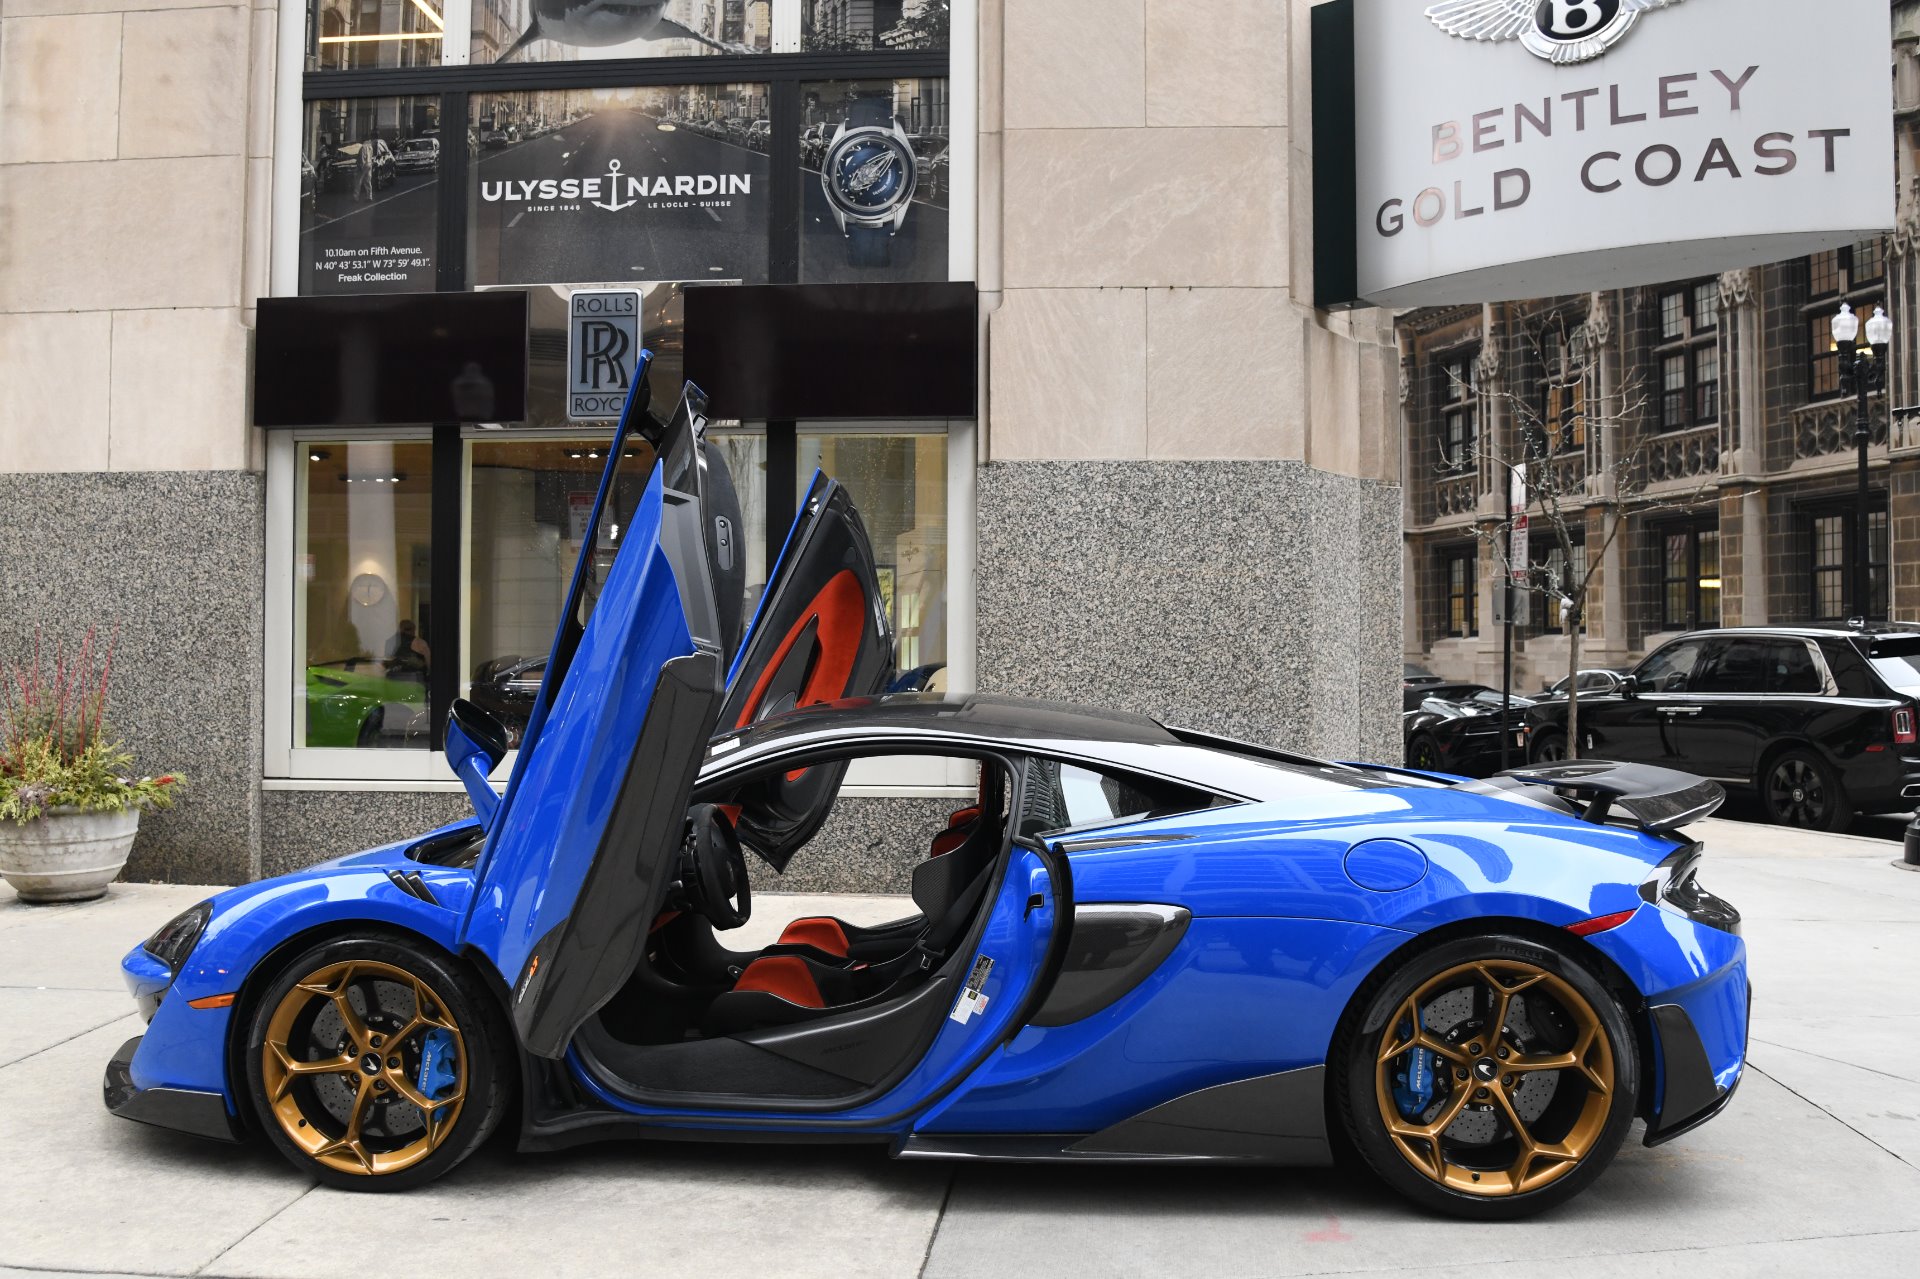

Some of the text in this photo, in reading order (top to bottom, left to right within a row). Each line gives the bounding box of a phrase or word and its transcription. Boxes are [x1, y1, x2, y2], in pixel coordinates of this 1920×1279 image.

[1431, 65, 1760, 165] BENTLEY
[481, 173, 751, 202] ULYSSE NARDIN
[1375, 128, 1851, 238] GOLD COAST
[699, 200, 732, 208] SUISSE
[325, 248, 356, 258] 10.10am
[370, 246, 389, 256] Fifth
[390, 246, 423, 255] Avenue.
[315, 261, 323, 270] N
[372, 259, 382, 268] W
[338, 272, 408, 282] Freak Collection
[576, 297, 633, 313] ROLLS
